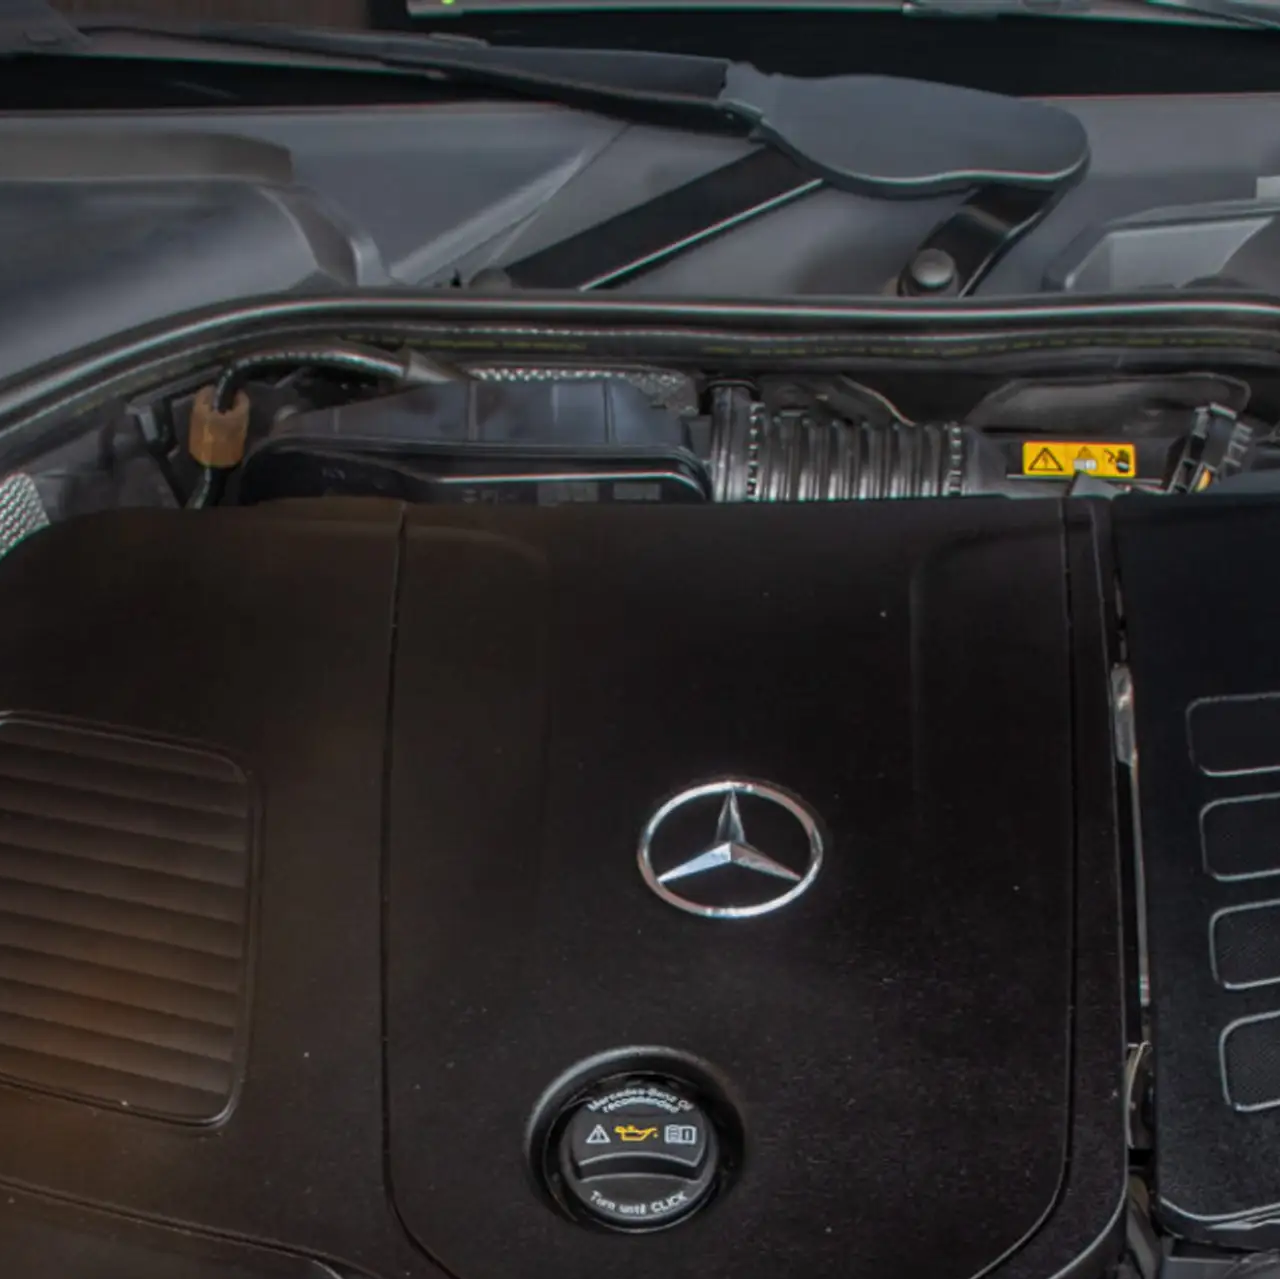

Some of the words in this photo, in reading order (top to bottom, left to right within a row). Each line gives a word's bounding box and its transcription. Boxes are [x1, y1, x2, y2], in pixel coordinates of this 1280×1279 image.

[590, 1189, 615, 1212] Turn
[619, 1203, 646, 1215] until
[650, 1190, 689, 1213] CLICK
